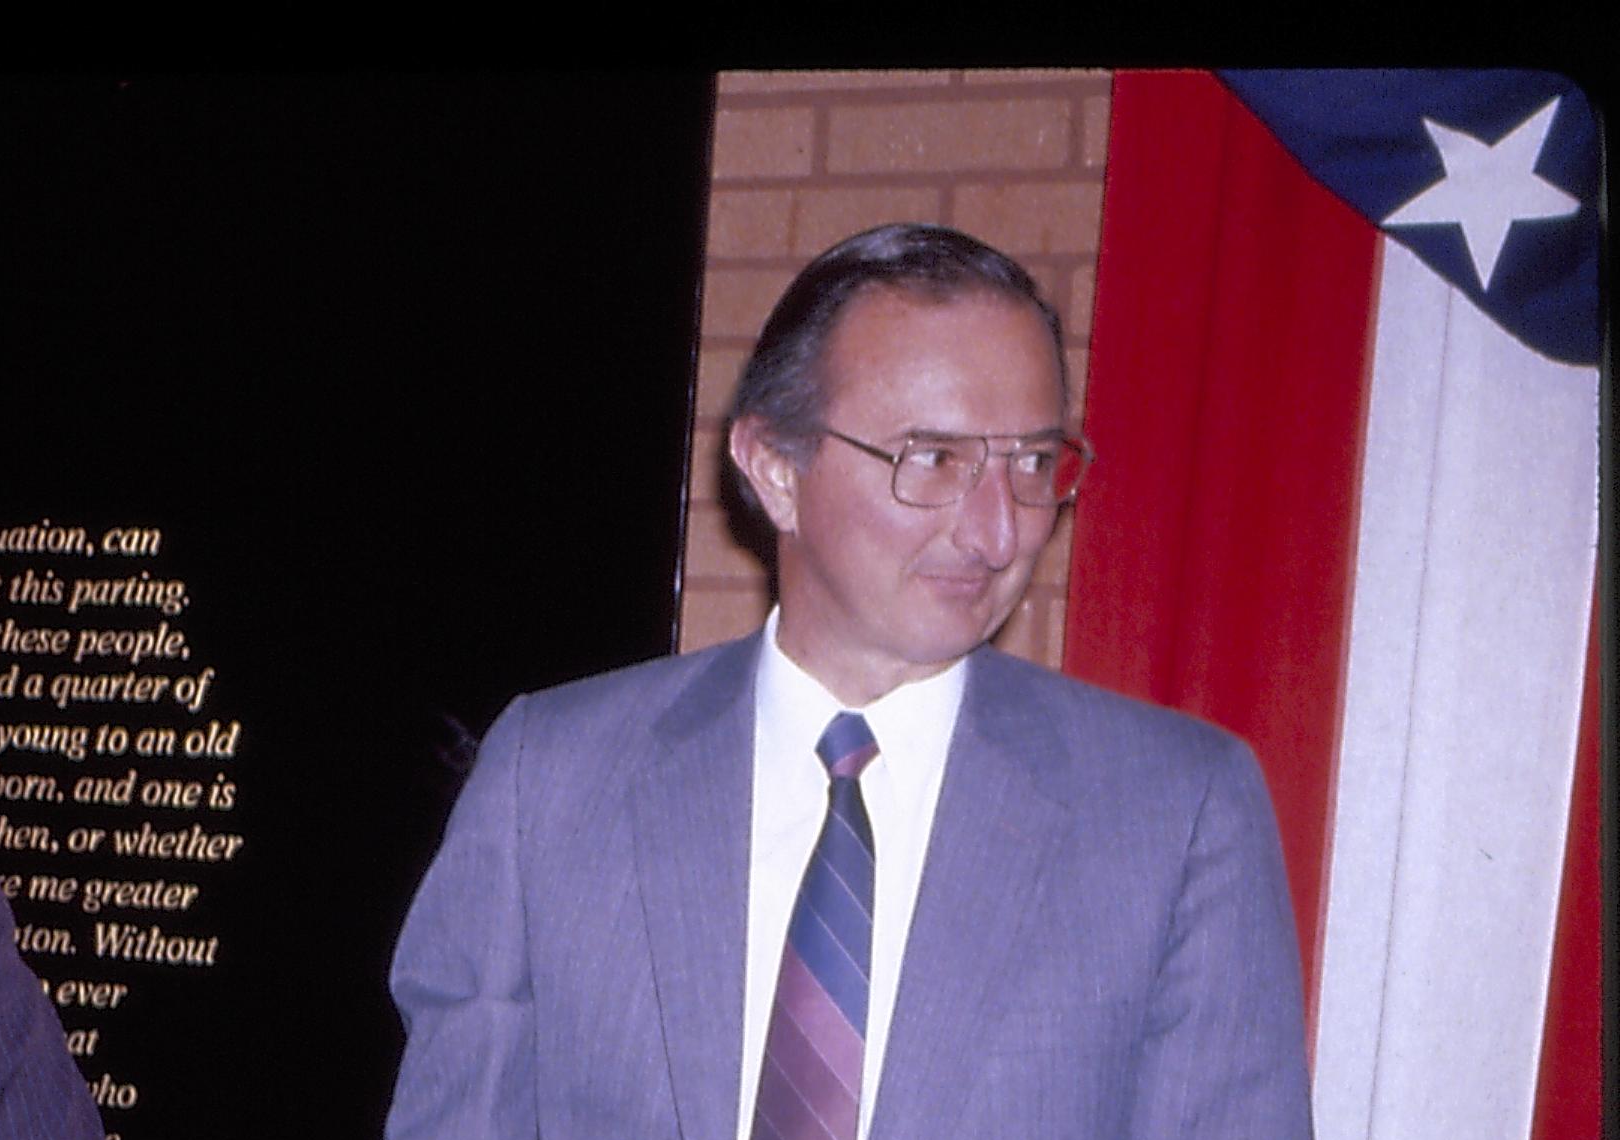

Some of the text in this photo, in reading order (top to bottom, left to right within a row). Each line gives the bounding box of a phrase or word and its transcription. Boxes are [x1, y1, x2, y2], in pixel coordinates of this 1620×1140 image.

[101, 527, 161, 555] can
[9, 569, 64, 603] this
[73, 621, 190, 664] people,
[23, 674, 43, 698] a
[50, 672, 168, 709] quarter
[173, 667, 215, 712] of
[95, 724, 128, 753] to
[135, 729, 176, 755] an
[183, 720, 241, 757] old
[73, 768, 137, 803] and
[141, 780, 203, 807] one
[208, 772, 236, 808] is
[67, 828, 105, 851] or
[113, 821, 244, 861] whether
[29, 875, 78, 901] me
[82, 878, 199, 913] greater
[95, 921, 219, 966] Without
[55, 979, 128, 1008] ever
